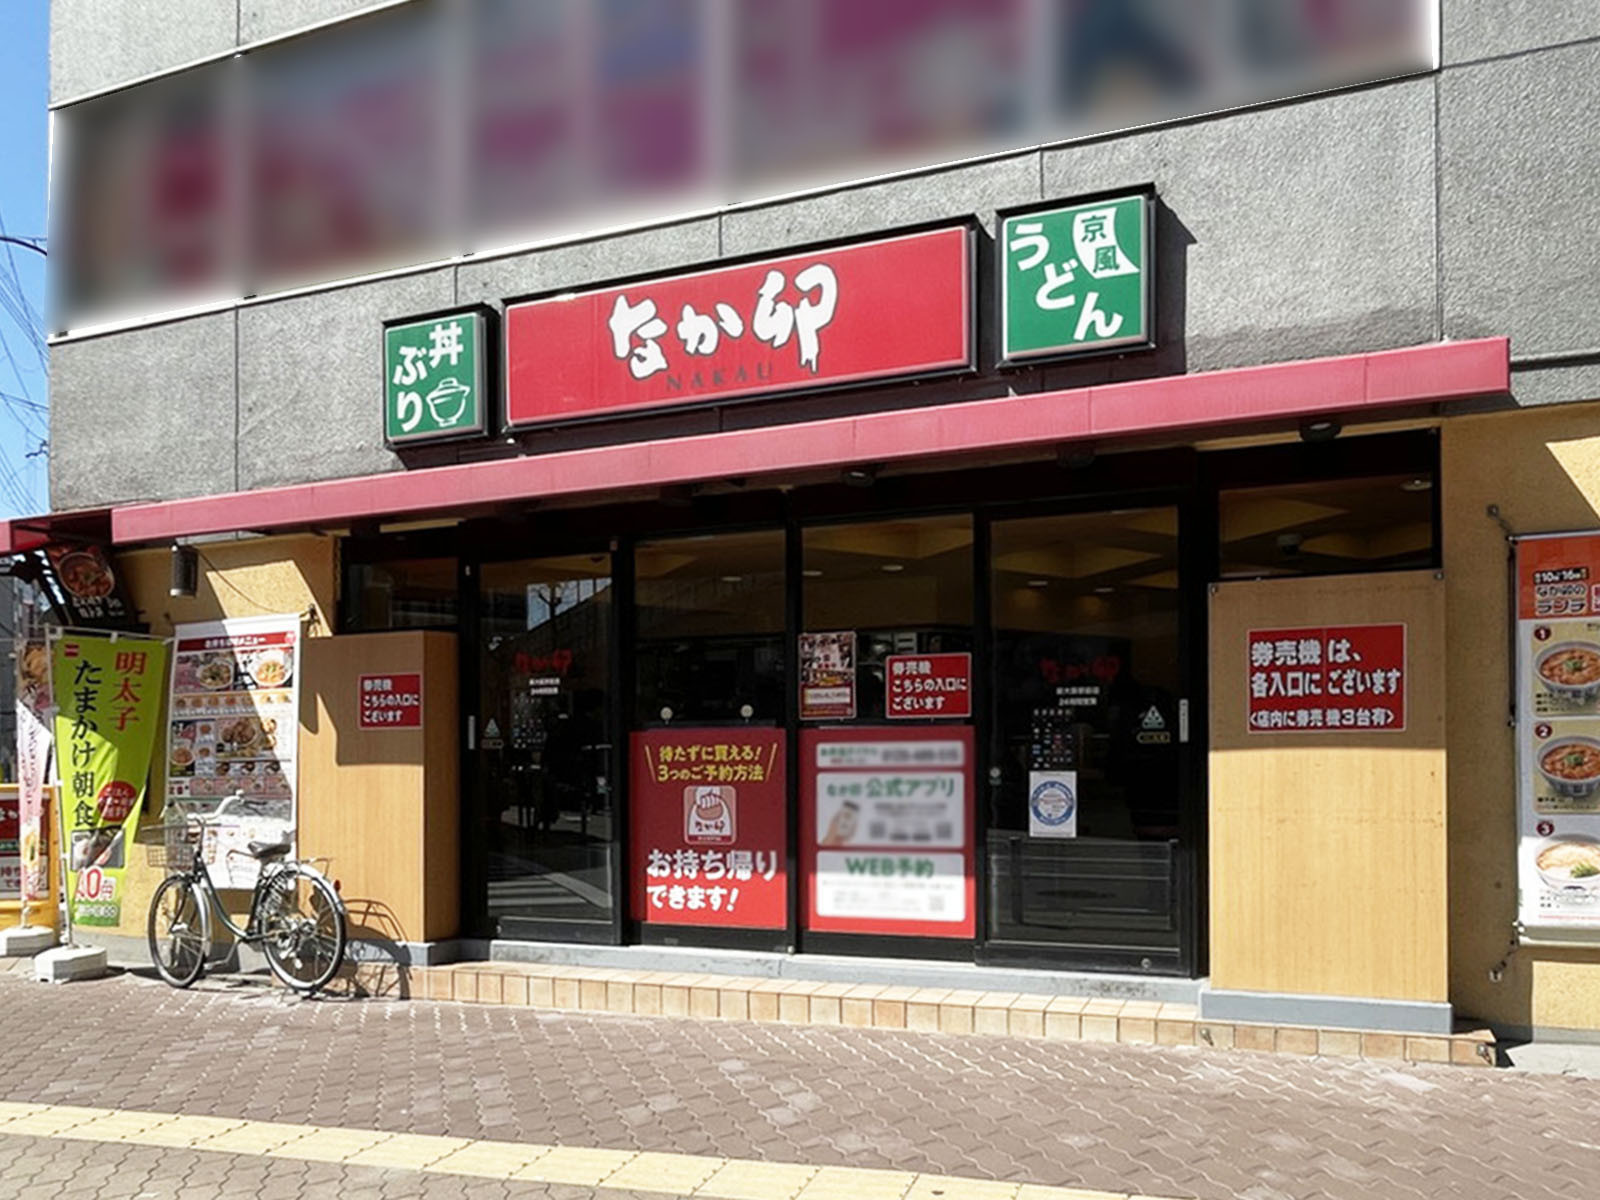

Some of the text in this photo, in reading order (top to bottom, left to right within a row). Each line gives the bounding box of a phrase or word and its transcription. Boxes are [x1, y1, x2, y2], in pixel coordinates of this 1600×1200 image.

[1080, 215, 1123, 272] 京風
[1008, 222, 1124, 342] うどん
[608, 263, 838, 380] なか卯
[667, 363, 774, 392] NAKAU
[110, 651, 147, 731] 明太子
[892, 677, 968, 693] こちらの入口に
[892, 695, 946, 711] ございます
[72, 660, 102, 827] たまかけ朝食
[657, 764, 765, 783] 3つのご予約方法
[646, 848, 777, 882] お持ち帰り
[646, 884, 740, 912] できます!
